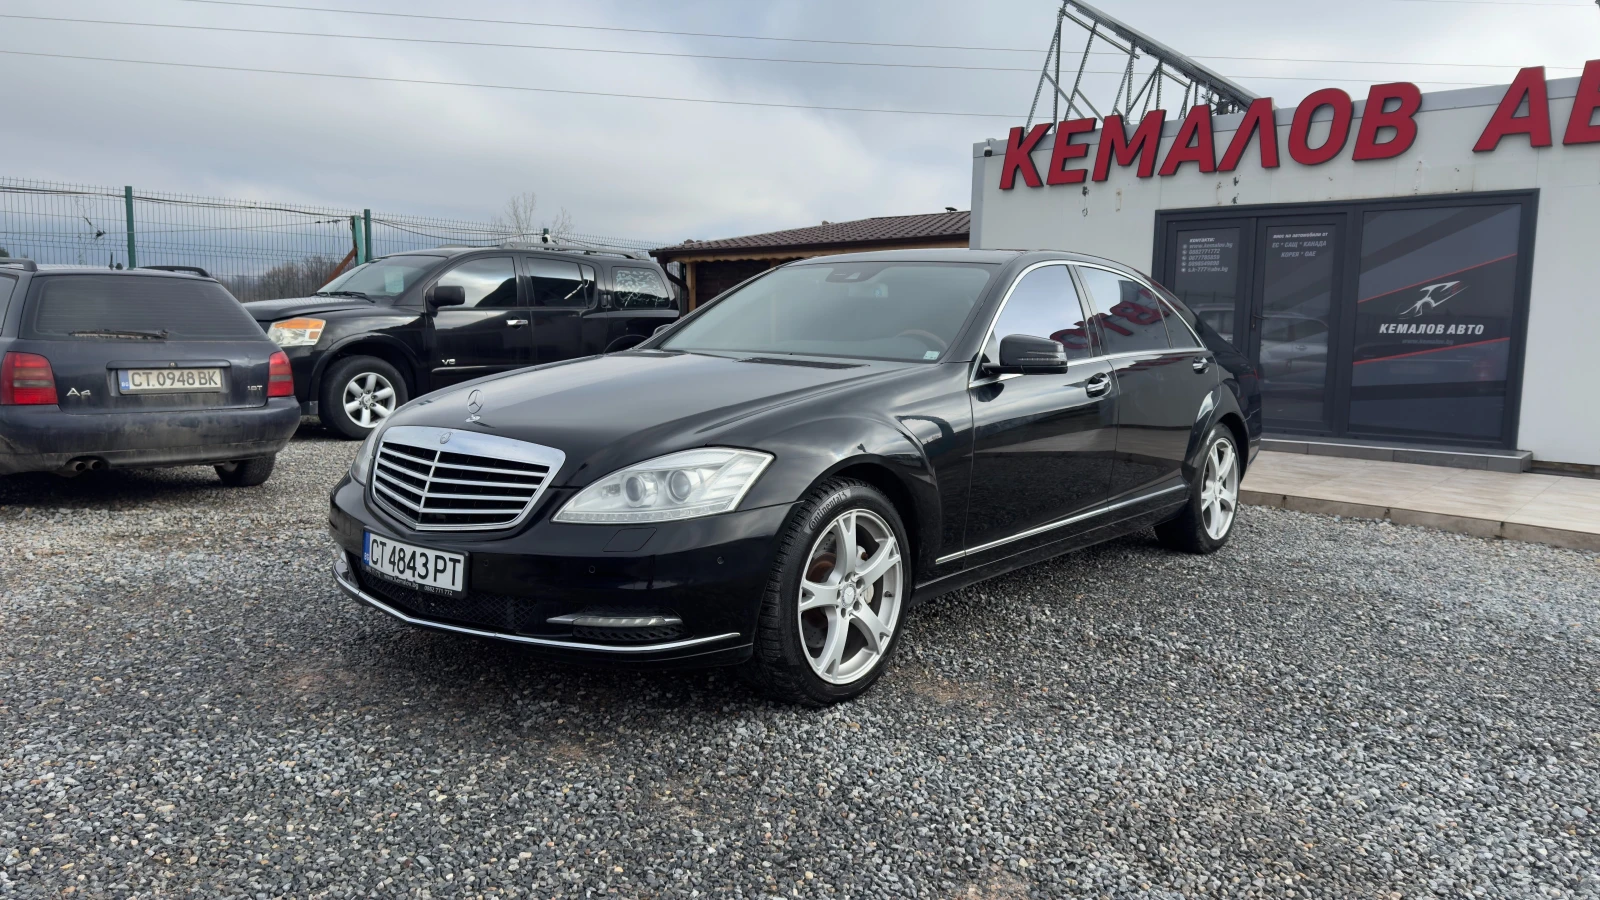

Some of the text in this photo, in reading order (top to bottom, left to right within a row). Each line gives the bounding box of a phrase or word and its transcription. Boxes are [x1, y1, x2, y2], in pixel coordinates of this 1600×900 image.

[999, 81, 1422, 190] КЕМАЛОВ
[1379, 323, 1485, 335] КЕМАЛОВ АВТО
[66, 387, 91, 397] A4
[131, 371, 218, 387] CT 0948 BK
[808, 493, 843, 531] Continental
[371, 539, 461, 586] CT 4843 PT
